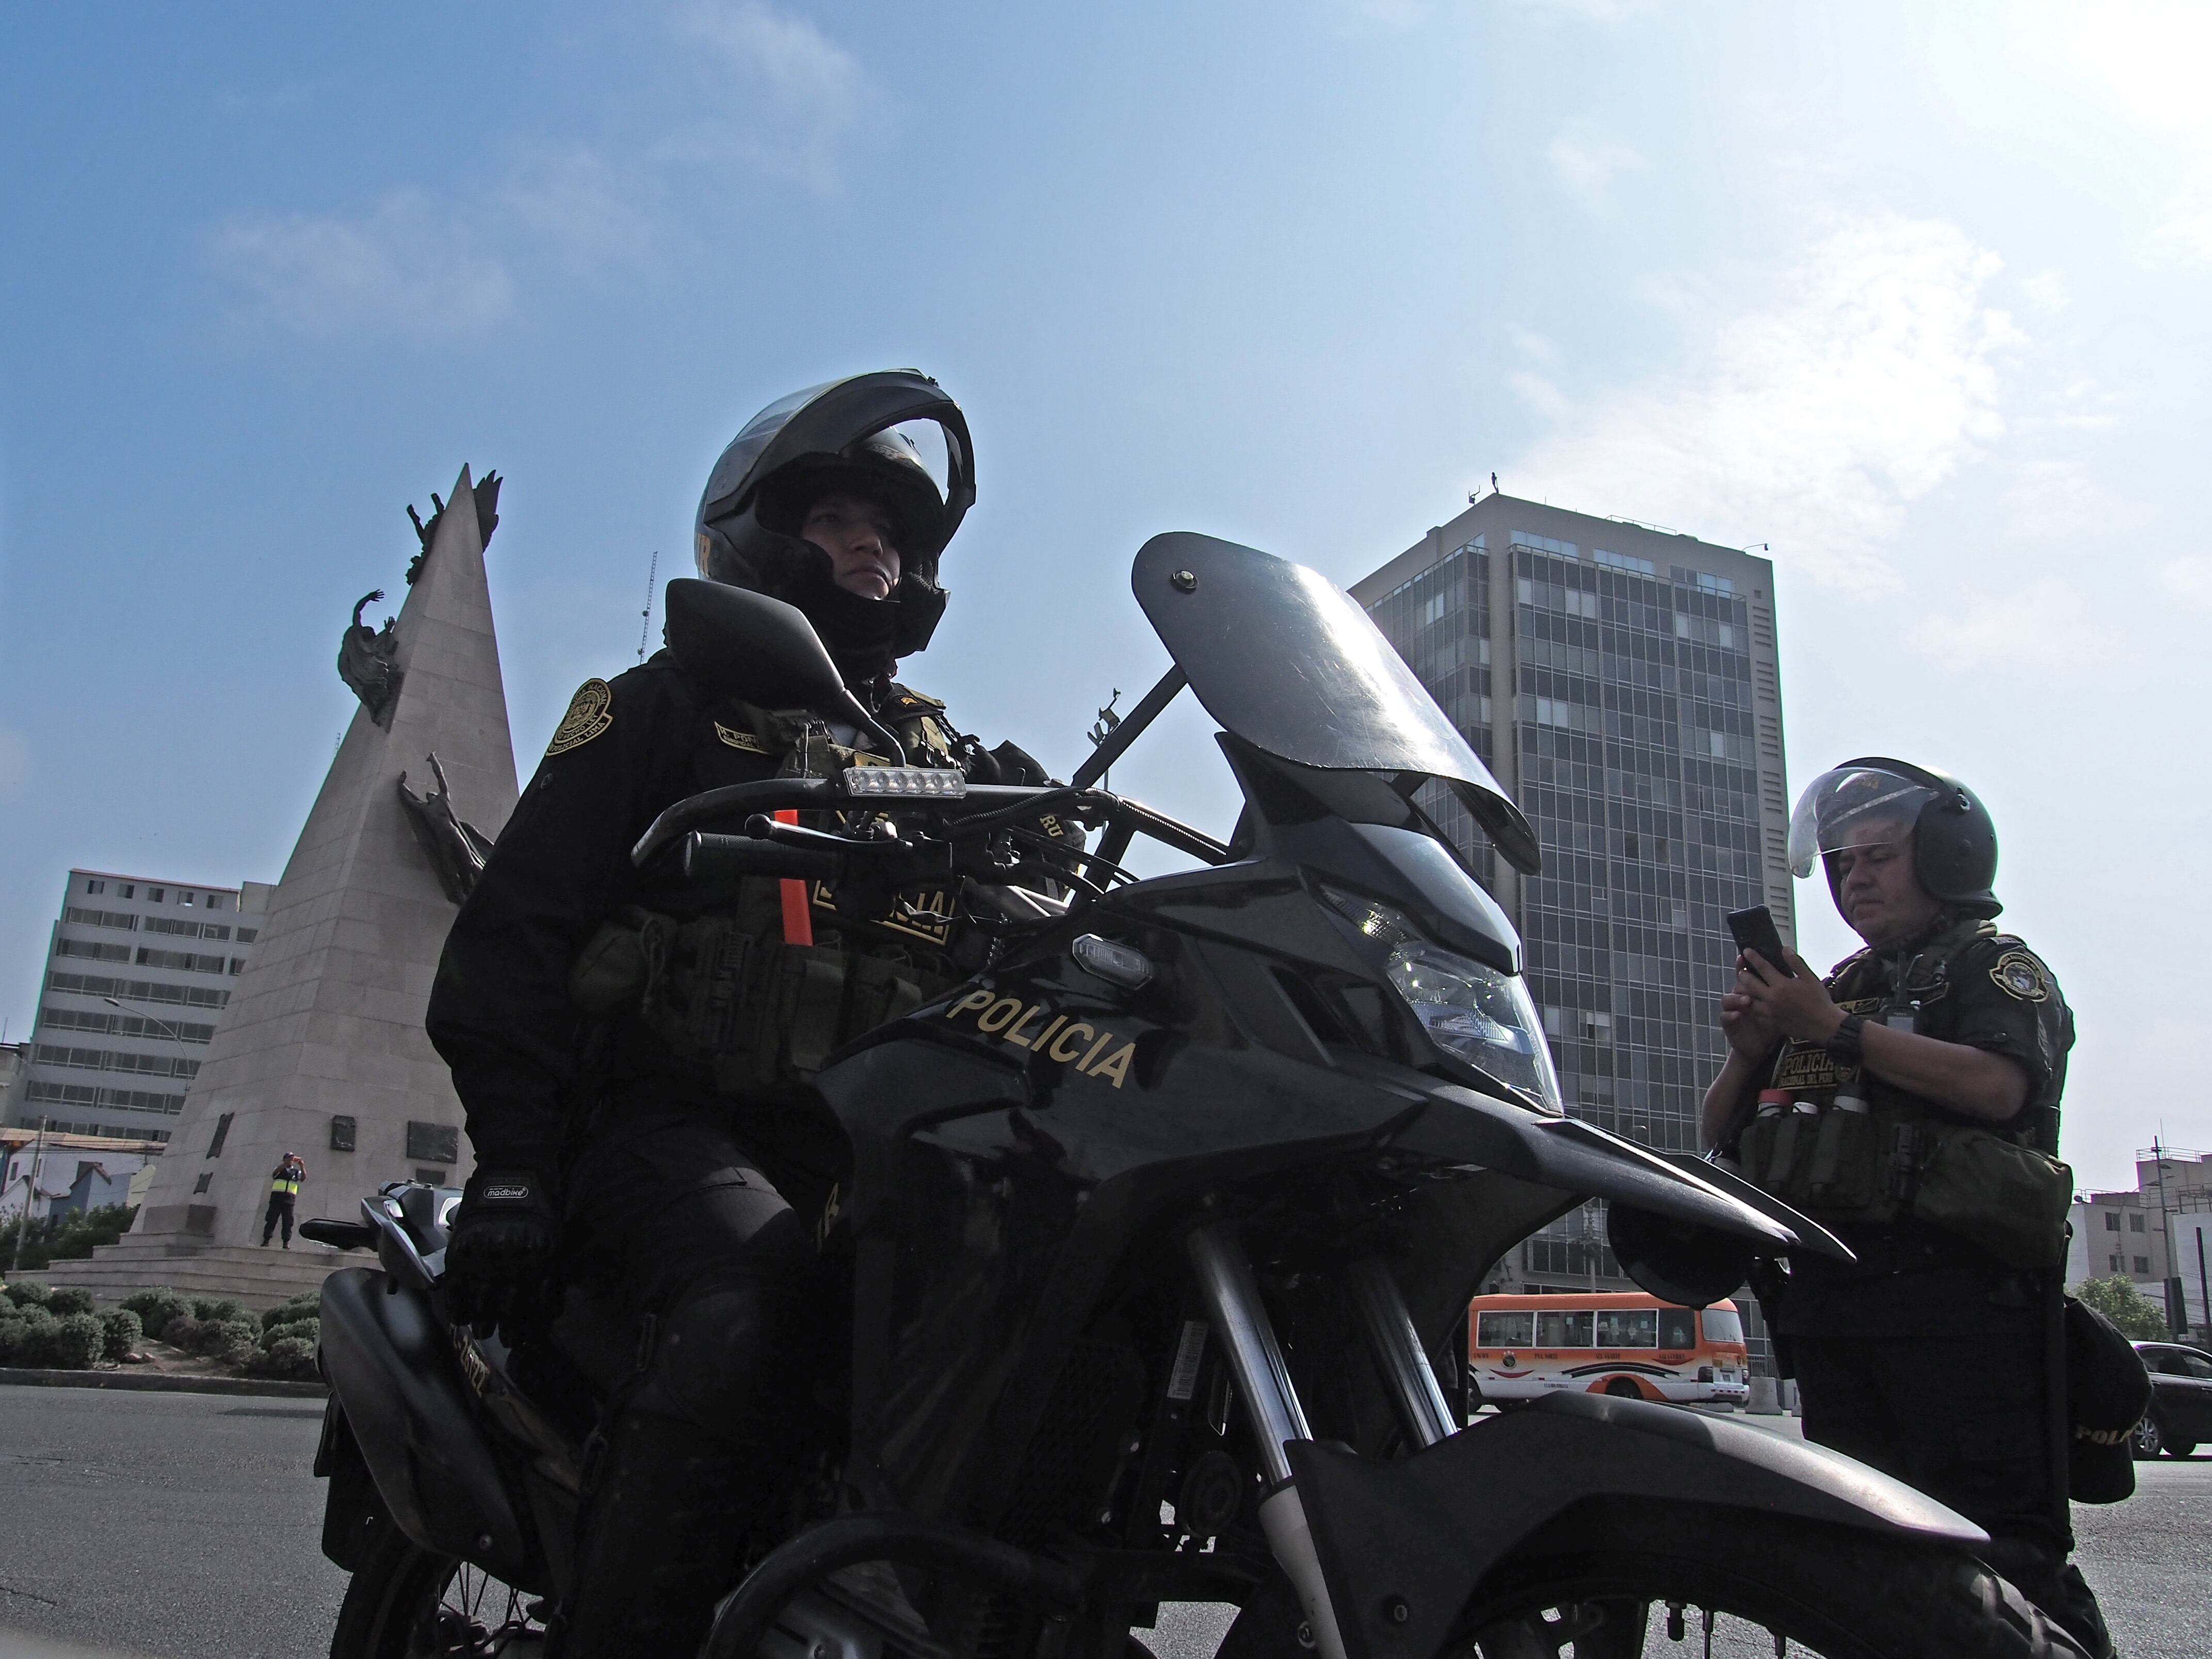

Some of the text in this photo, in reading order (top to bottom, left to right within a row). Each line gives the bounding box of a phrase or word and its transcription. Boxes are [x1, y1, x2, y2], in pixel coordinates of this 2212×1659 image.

[588, 684, 607, 706] NACIONAL
[587, 714, 599, 725] LEY
[584, 722, 606, 738] LIMA
[946, 989, 1136, 1088] POLICIA
[487, 1188, 523, 1196] madbike
